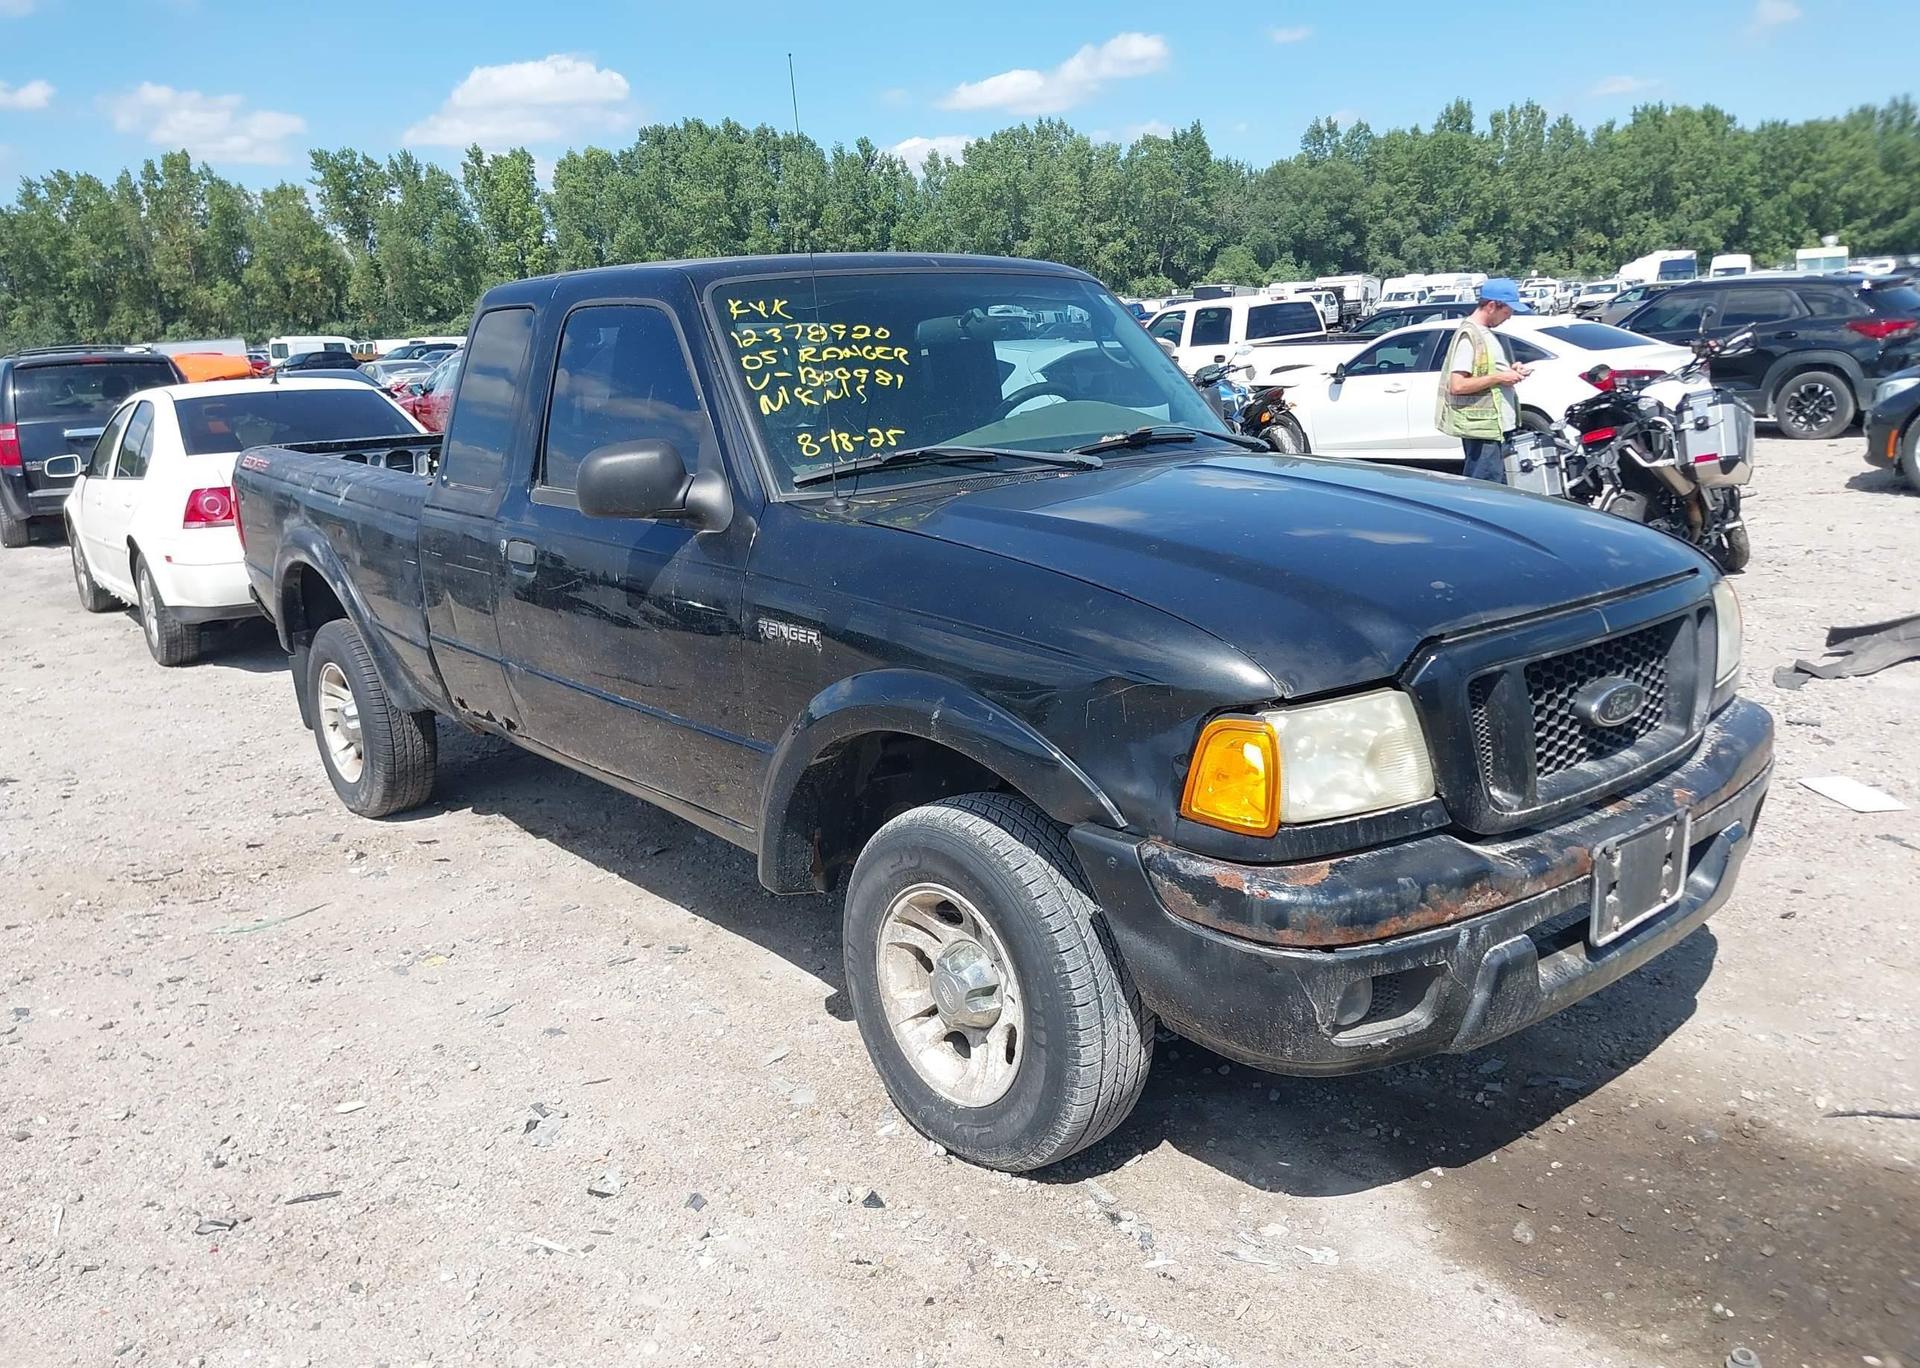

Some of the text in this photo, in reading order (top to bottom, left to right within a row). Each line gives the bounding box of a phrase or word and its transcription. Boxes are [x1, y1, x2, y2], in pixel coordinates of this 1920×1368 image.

[730, 323, 891, 348] 12378920
[798, 345, 910, 366] RANGER
[797, 428, 905, 456] 8-18-25
[758, 618, 823, 648] RANGER
